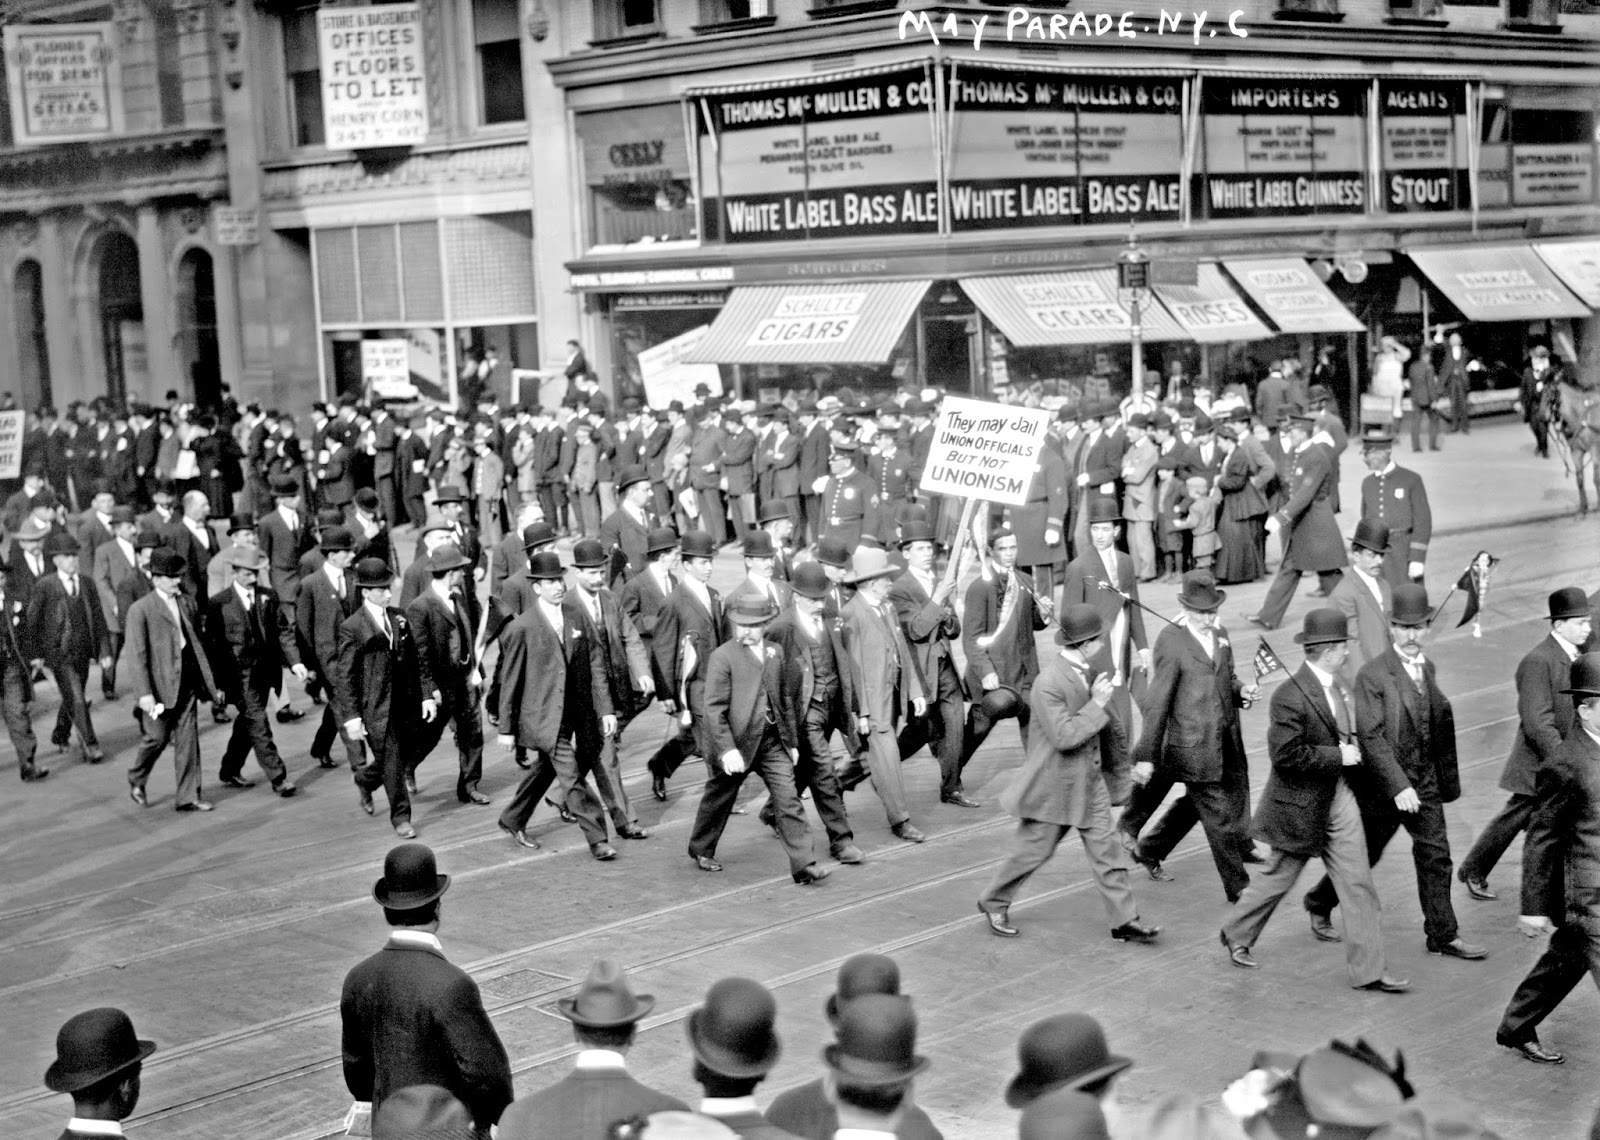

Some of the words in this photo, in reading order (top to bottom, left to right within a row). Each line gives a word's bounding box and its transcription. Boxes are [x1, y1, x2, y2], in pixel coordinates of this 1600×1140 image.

[367, 10, 421, 26] BASEMENT
[34, 40, 86, 52] FLOORS
[331, 28, 415, 49] OFFICES
[27, 69, 53, 82] FOR
[61, 66, 98, 82] RENT
[333, 56, 415, 76] FLOORS
[329, 80, 361, 100] TO
[371, 77, 423, 98] LET
[949, 79, 1029, 104] THOMAS
[1063, 83, 1131, 106] MULLEN
[1135, 84, 1149, 105] &
[1231, 88, 1340, 109] IMPORTERS
[721, 97, 786, 124] THOMAS
[814, 87, 881, 114] MULLEN
[887, 84, 902, 108] &
[1387, 91, 1449, 109] AGENTS
[382, 109, 423, 123] CORN
[808, 147, 845, 160] CADET
[951, 186, 1017, 221] WHITE
[1021, 184, 1082, 217] LABEL
[1088, 180, 1142, 214] BASS
[1145, 179, 1181, 212] ALE
[1210, 178, 1254, 209] WHITE
[1255, 177, 1295, 209] LABEL
[1295, 175, 1363, 207] GUINNESS
[1391, 174, 1450, 205] STOUT
[726, 200, 781, 233] WHITE
[784, 196, 841, 230] LABEL
[844, 192, 897, 226] BASS
[901, 189, 938, 223] ALE
[781, 294, 857, 314] SCHULTE
[1022, 284, 1098, 303] SCHULTE
[1038, 308, 1125, 329] CIGARS
[1177, 301, 1248, 326] ROSES
[759, 319, 848, 341] CIGARS
[948, 411, 976, 433] They
[977, 418, 1008, 434] may
[1010, 416, 1039, 436] Jail
[940, 431, 975, 448] UNION
[975, 437, 1034, 457] OFFICIALS
[946, 450, 978, 465] BUT
[978, 455, 1009, 470] NOT
[931, 465, 1024, 494] UNIONISM
